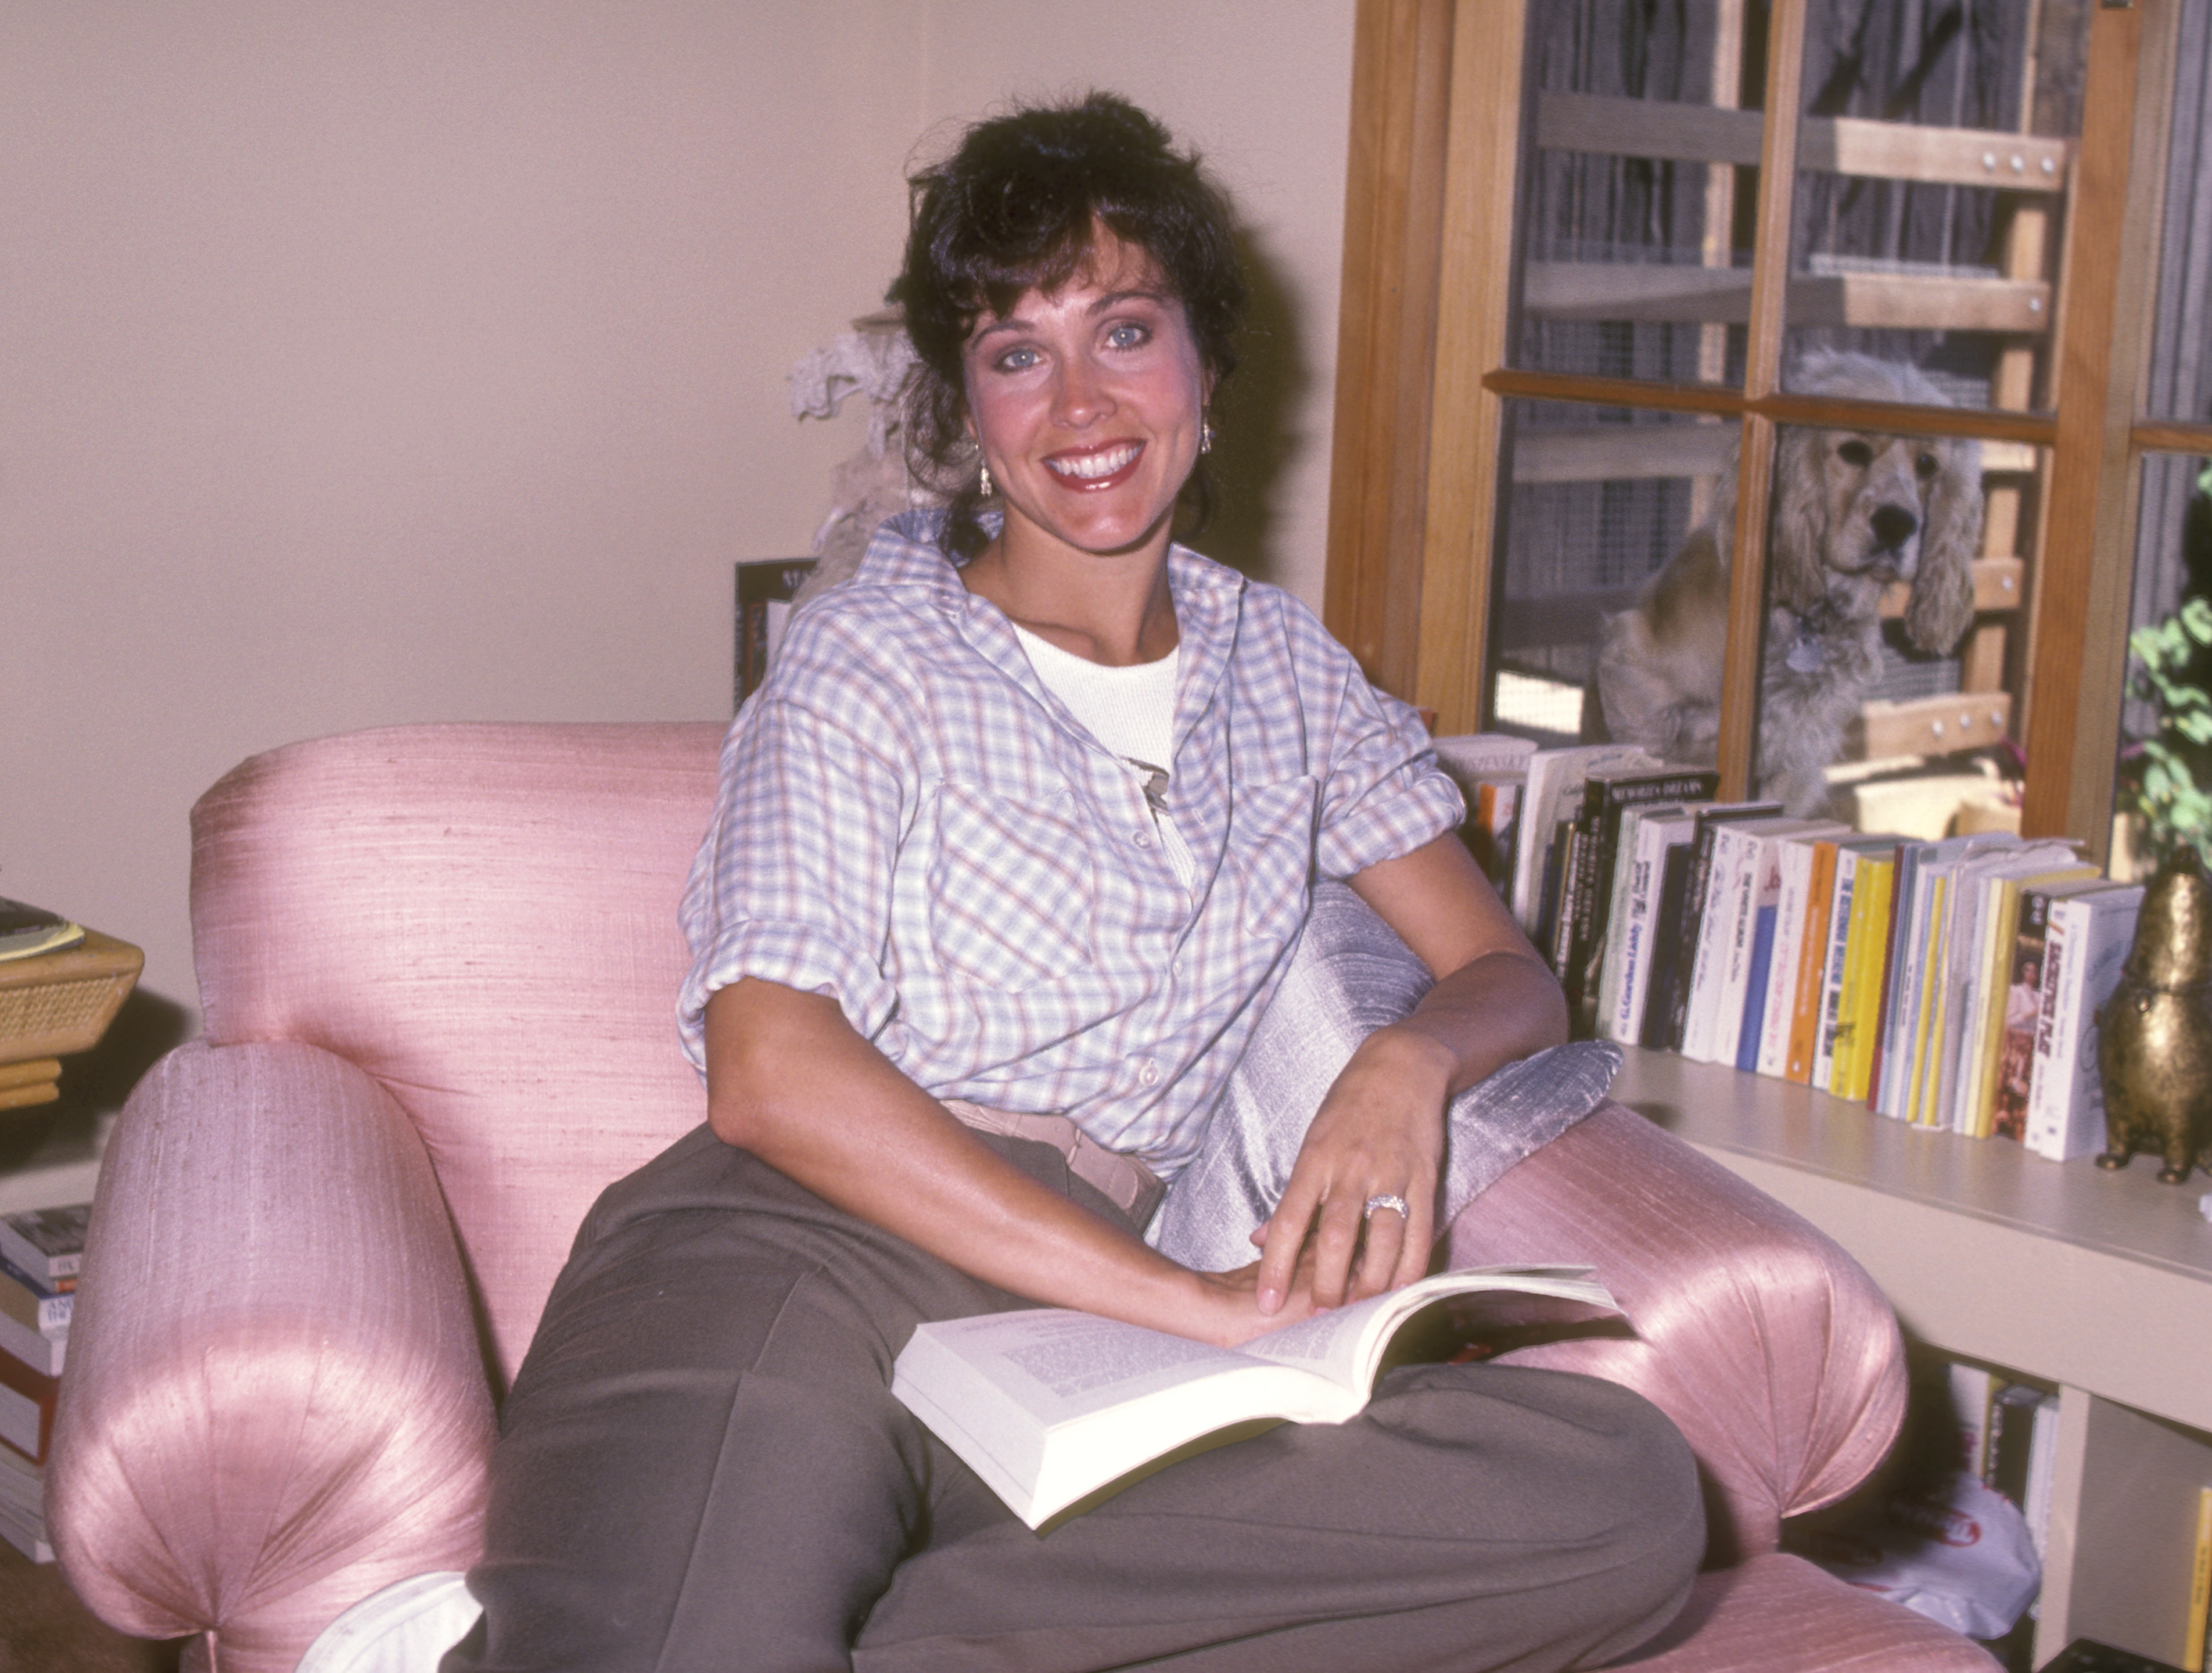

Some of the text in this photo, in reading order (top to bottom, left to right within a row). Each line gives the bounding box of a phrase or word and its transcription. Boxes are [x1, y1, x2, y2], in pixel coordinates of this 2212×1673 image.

[1743, 872, 1752, 887] THE
[1740, 889, 1750, 916] WHITE
[1736, 918, 1745, 947] ALBUM
[2037, 1018, 2053, 1058] PLAY
